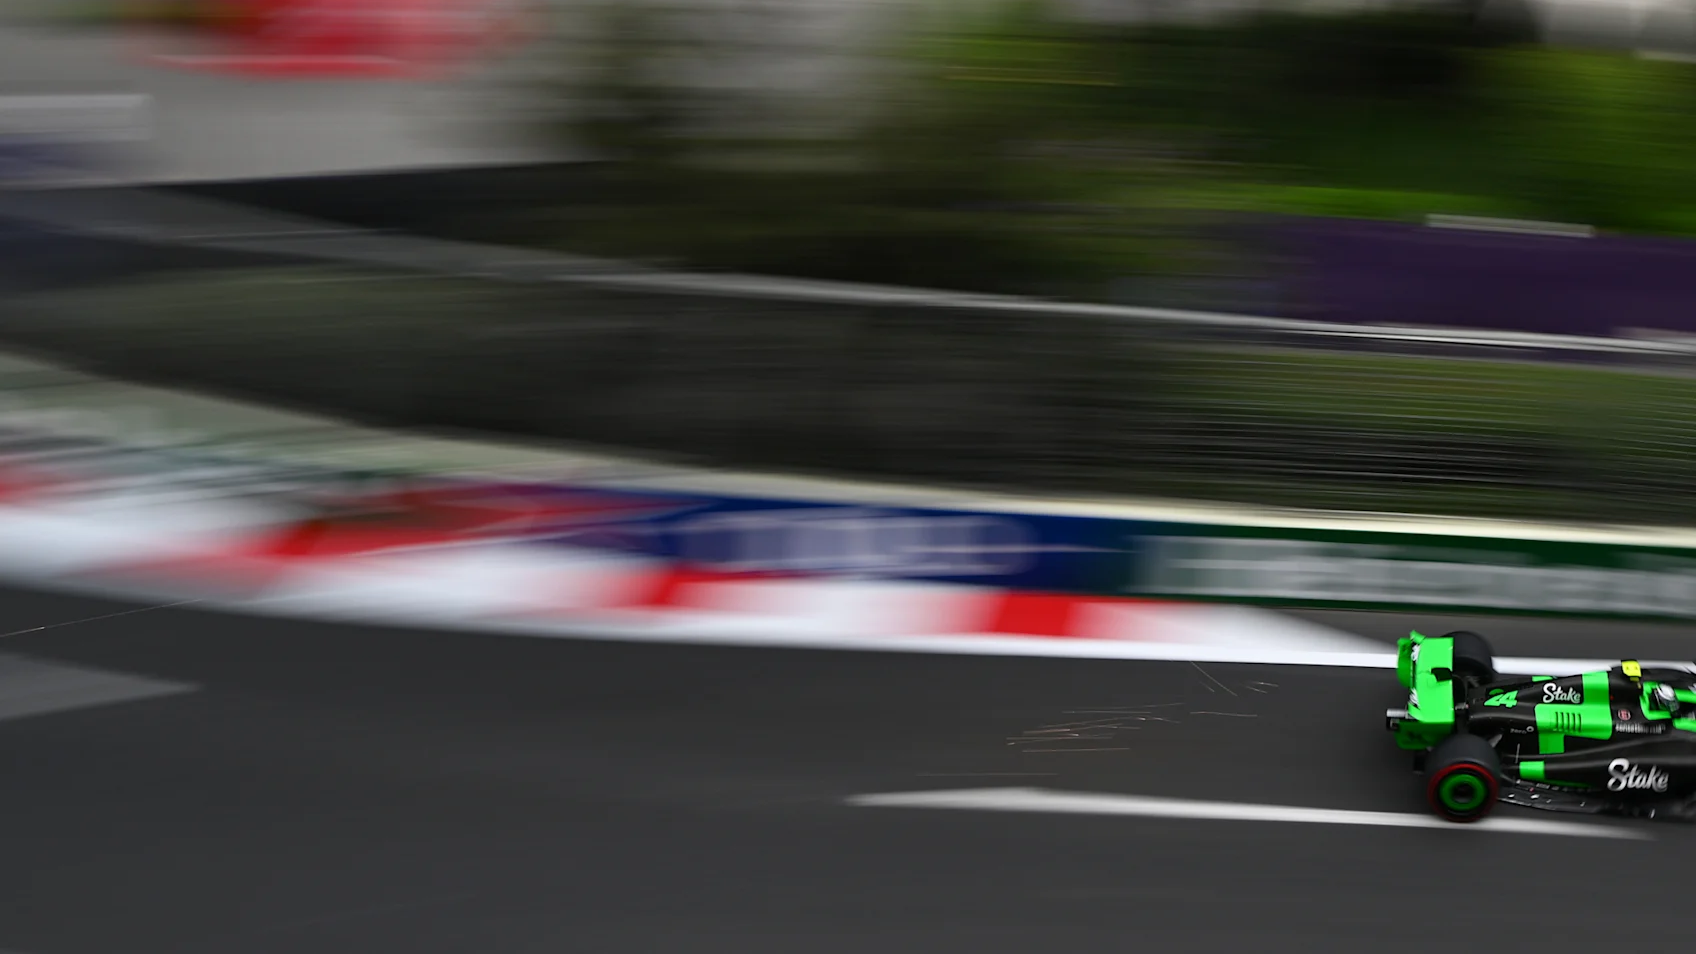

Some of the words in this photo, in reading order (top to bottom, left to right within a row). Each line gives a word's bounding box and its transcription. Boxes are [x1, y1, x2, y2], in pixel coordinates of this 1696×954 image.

[1484, 688, 1518, 708] 24
[1543, 682, 1581, 704] Stake
[1607, 758, 1669, 792] Stake
